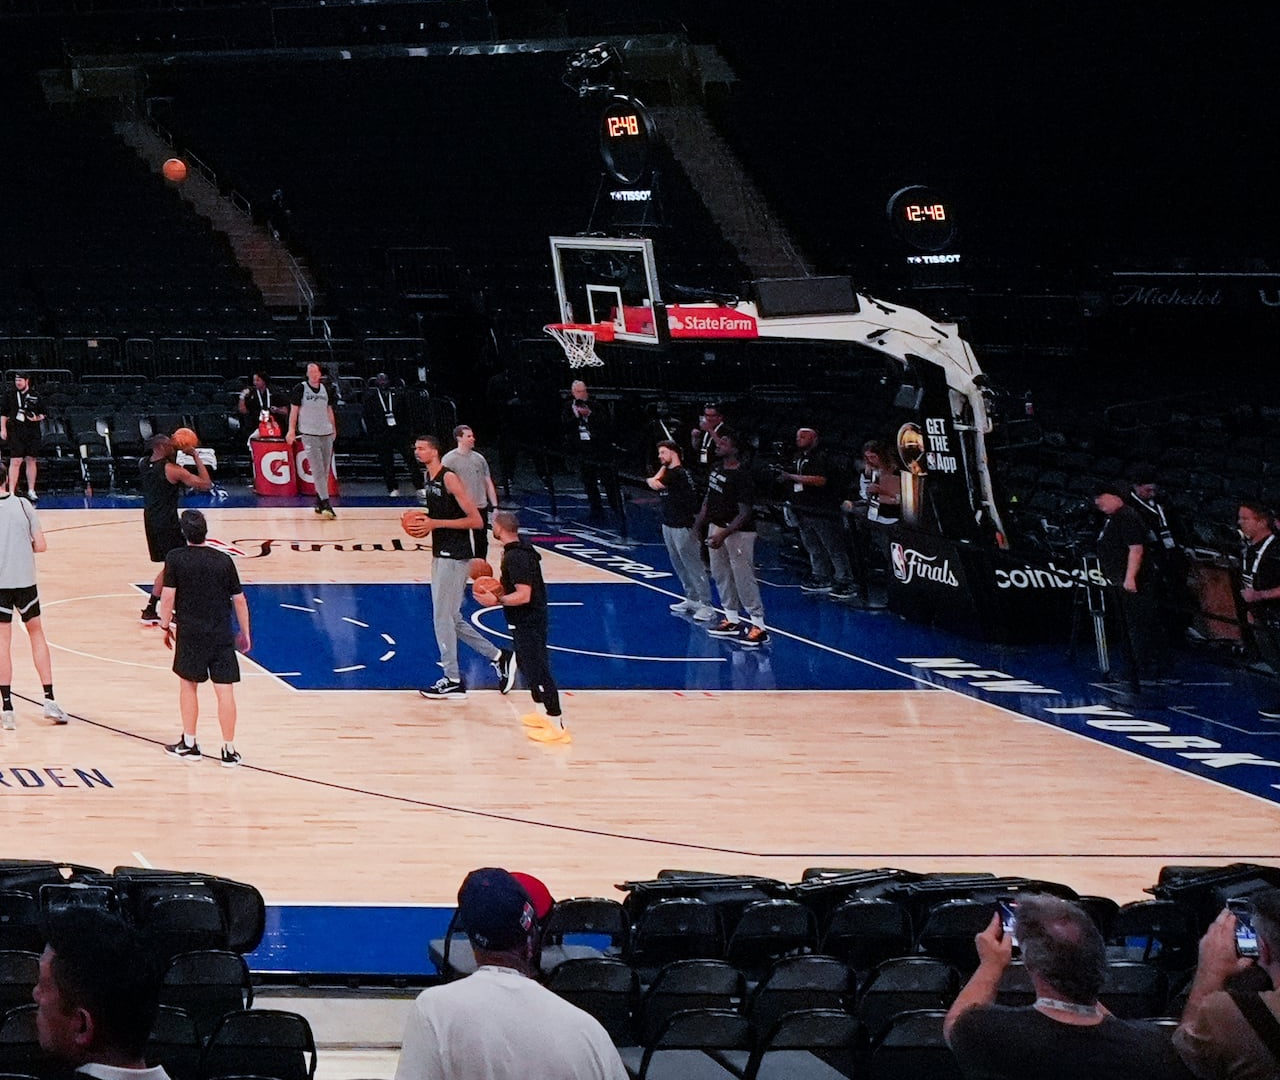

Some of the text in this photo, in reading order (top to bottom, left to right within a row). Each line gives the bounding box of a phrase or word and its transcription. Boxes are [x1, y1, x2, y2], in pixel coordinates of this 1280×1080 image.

[607, 115, 639, 137] 12:48
[905, 205, 946, 221] 12:48
[923, 254, 961, 264] TISSOT
[1112, 283, 1222, 306] Michelob
[926, 418, 945, 435] GET
[928, 435, 949, 452] THE
[260, 450, 290, 485] G
[936, 453, 957, 473] App
[232, 538, 433, 559] Finals
[554, 543, 673, 579] ULTRA
[902, 548, 959, 587] Finals
[895, 657, 1280, 769] NEW YORK
